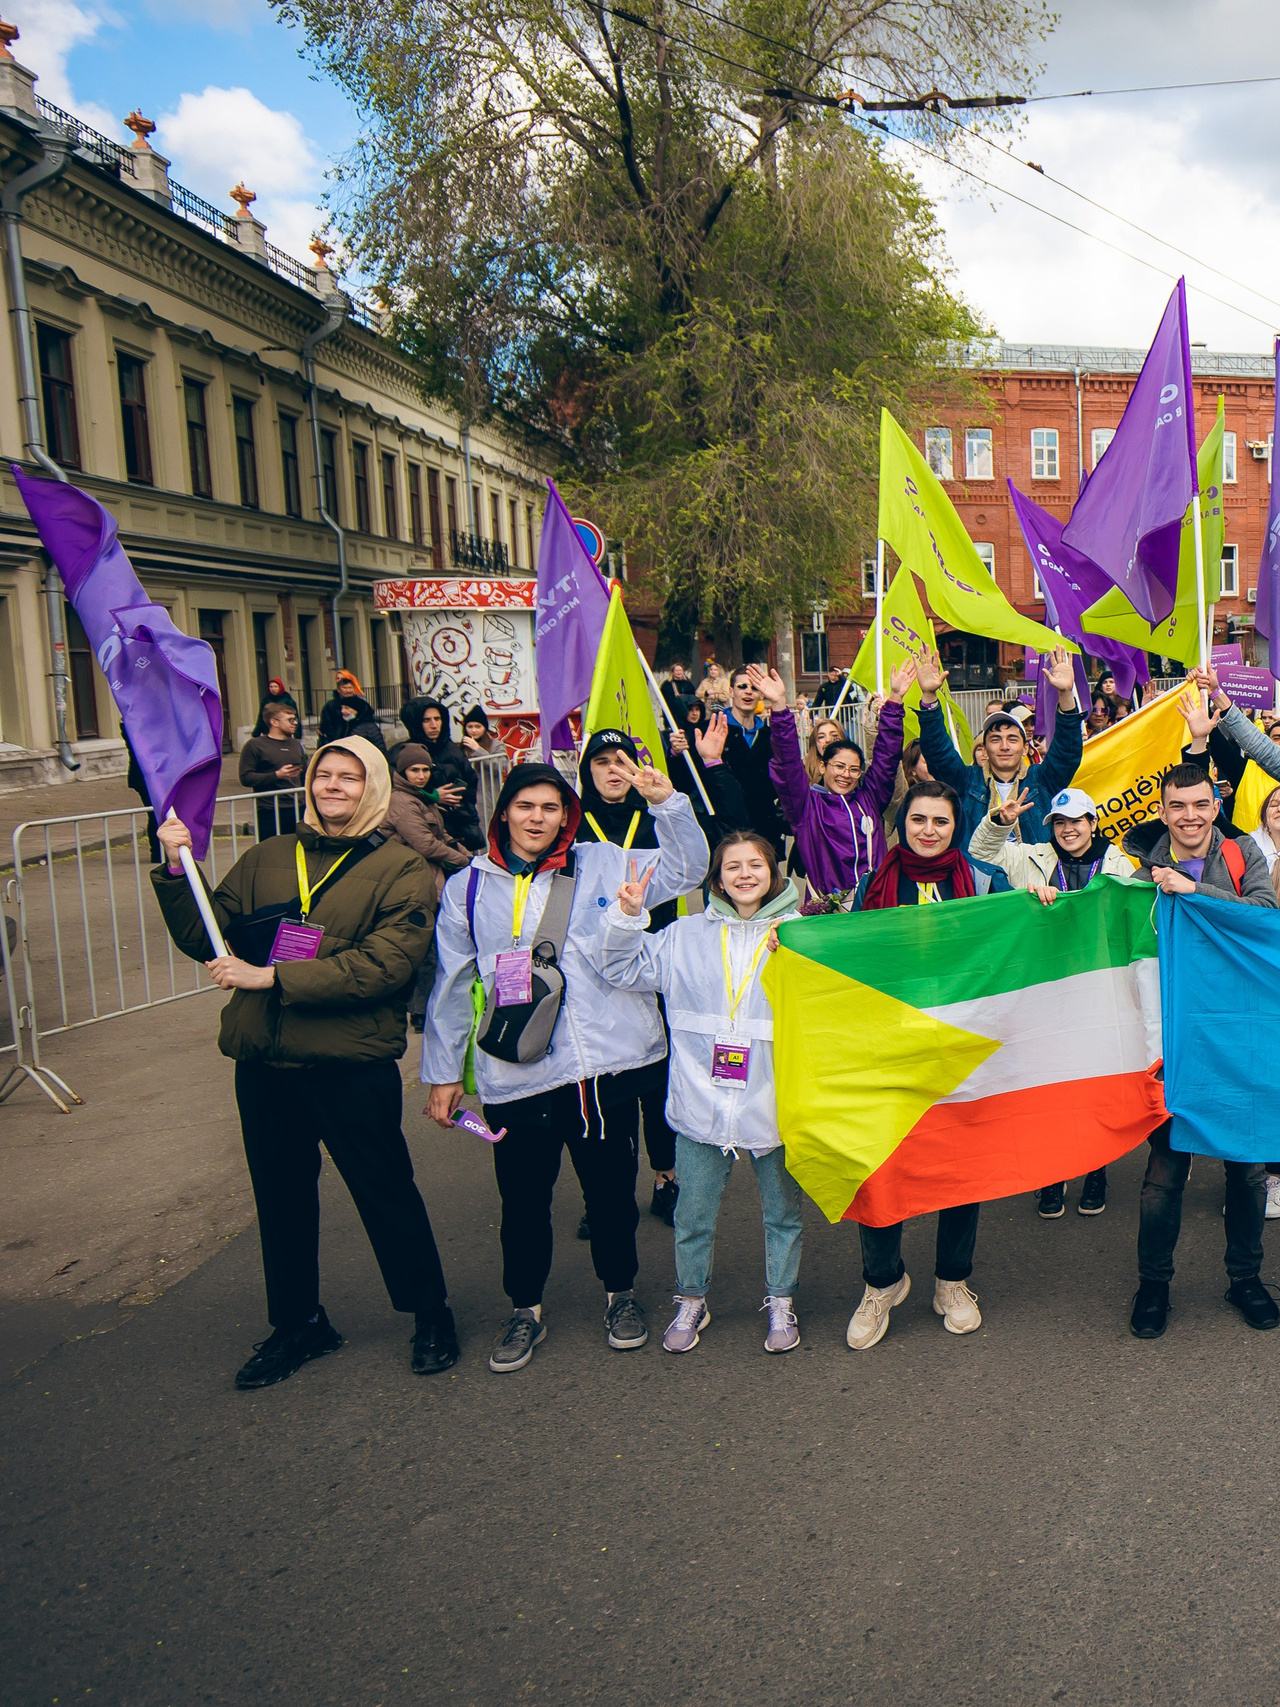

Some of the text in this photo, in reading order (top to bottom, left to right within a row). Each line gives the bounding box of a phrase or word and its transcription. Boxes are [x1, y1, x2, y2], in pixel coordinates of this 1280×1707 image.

[466, 582, 492, 596] 49
[1221, 681, 1269, 692] САМАРСКАЯ
[1227, 689, 1262, 699] ОБЛАСТЬ
